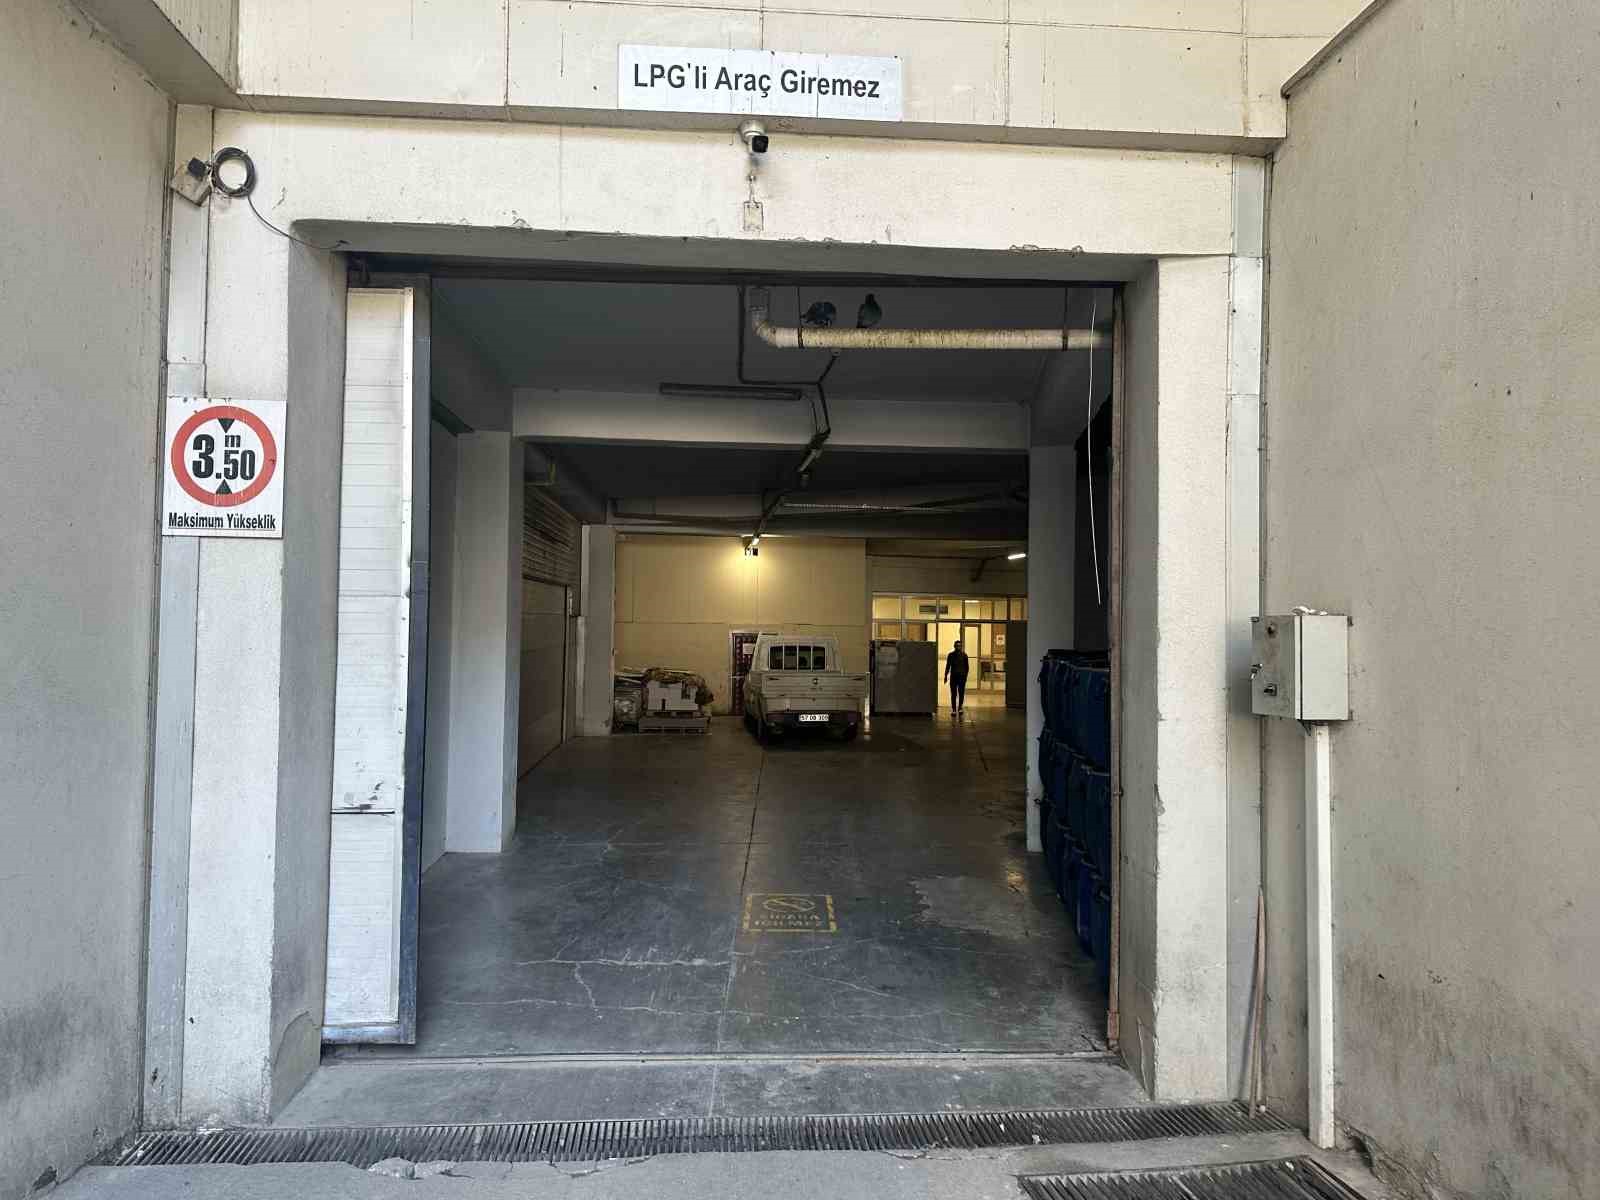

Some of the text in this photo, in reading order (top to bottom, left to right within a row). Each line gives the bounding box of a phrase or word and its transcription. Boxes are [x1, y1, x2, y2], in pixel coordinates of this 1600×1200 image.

[633, 62, 880, 98] LPG'li Araç Giremez
[224, 434, 241, 448] m
[192, 433, 256, 480] 3.50
[168, 512, 276, 529] Maksimum Yükseklik
